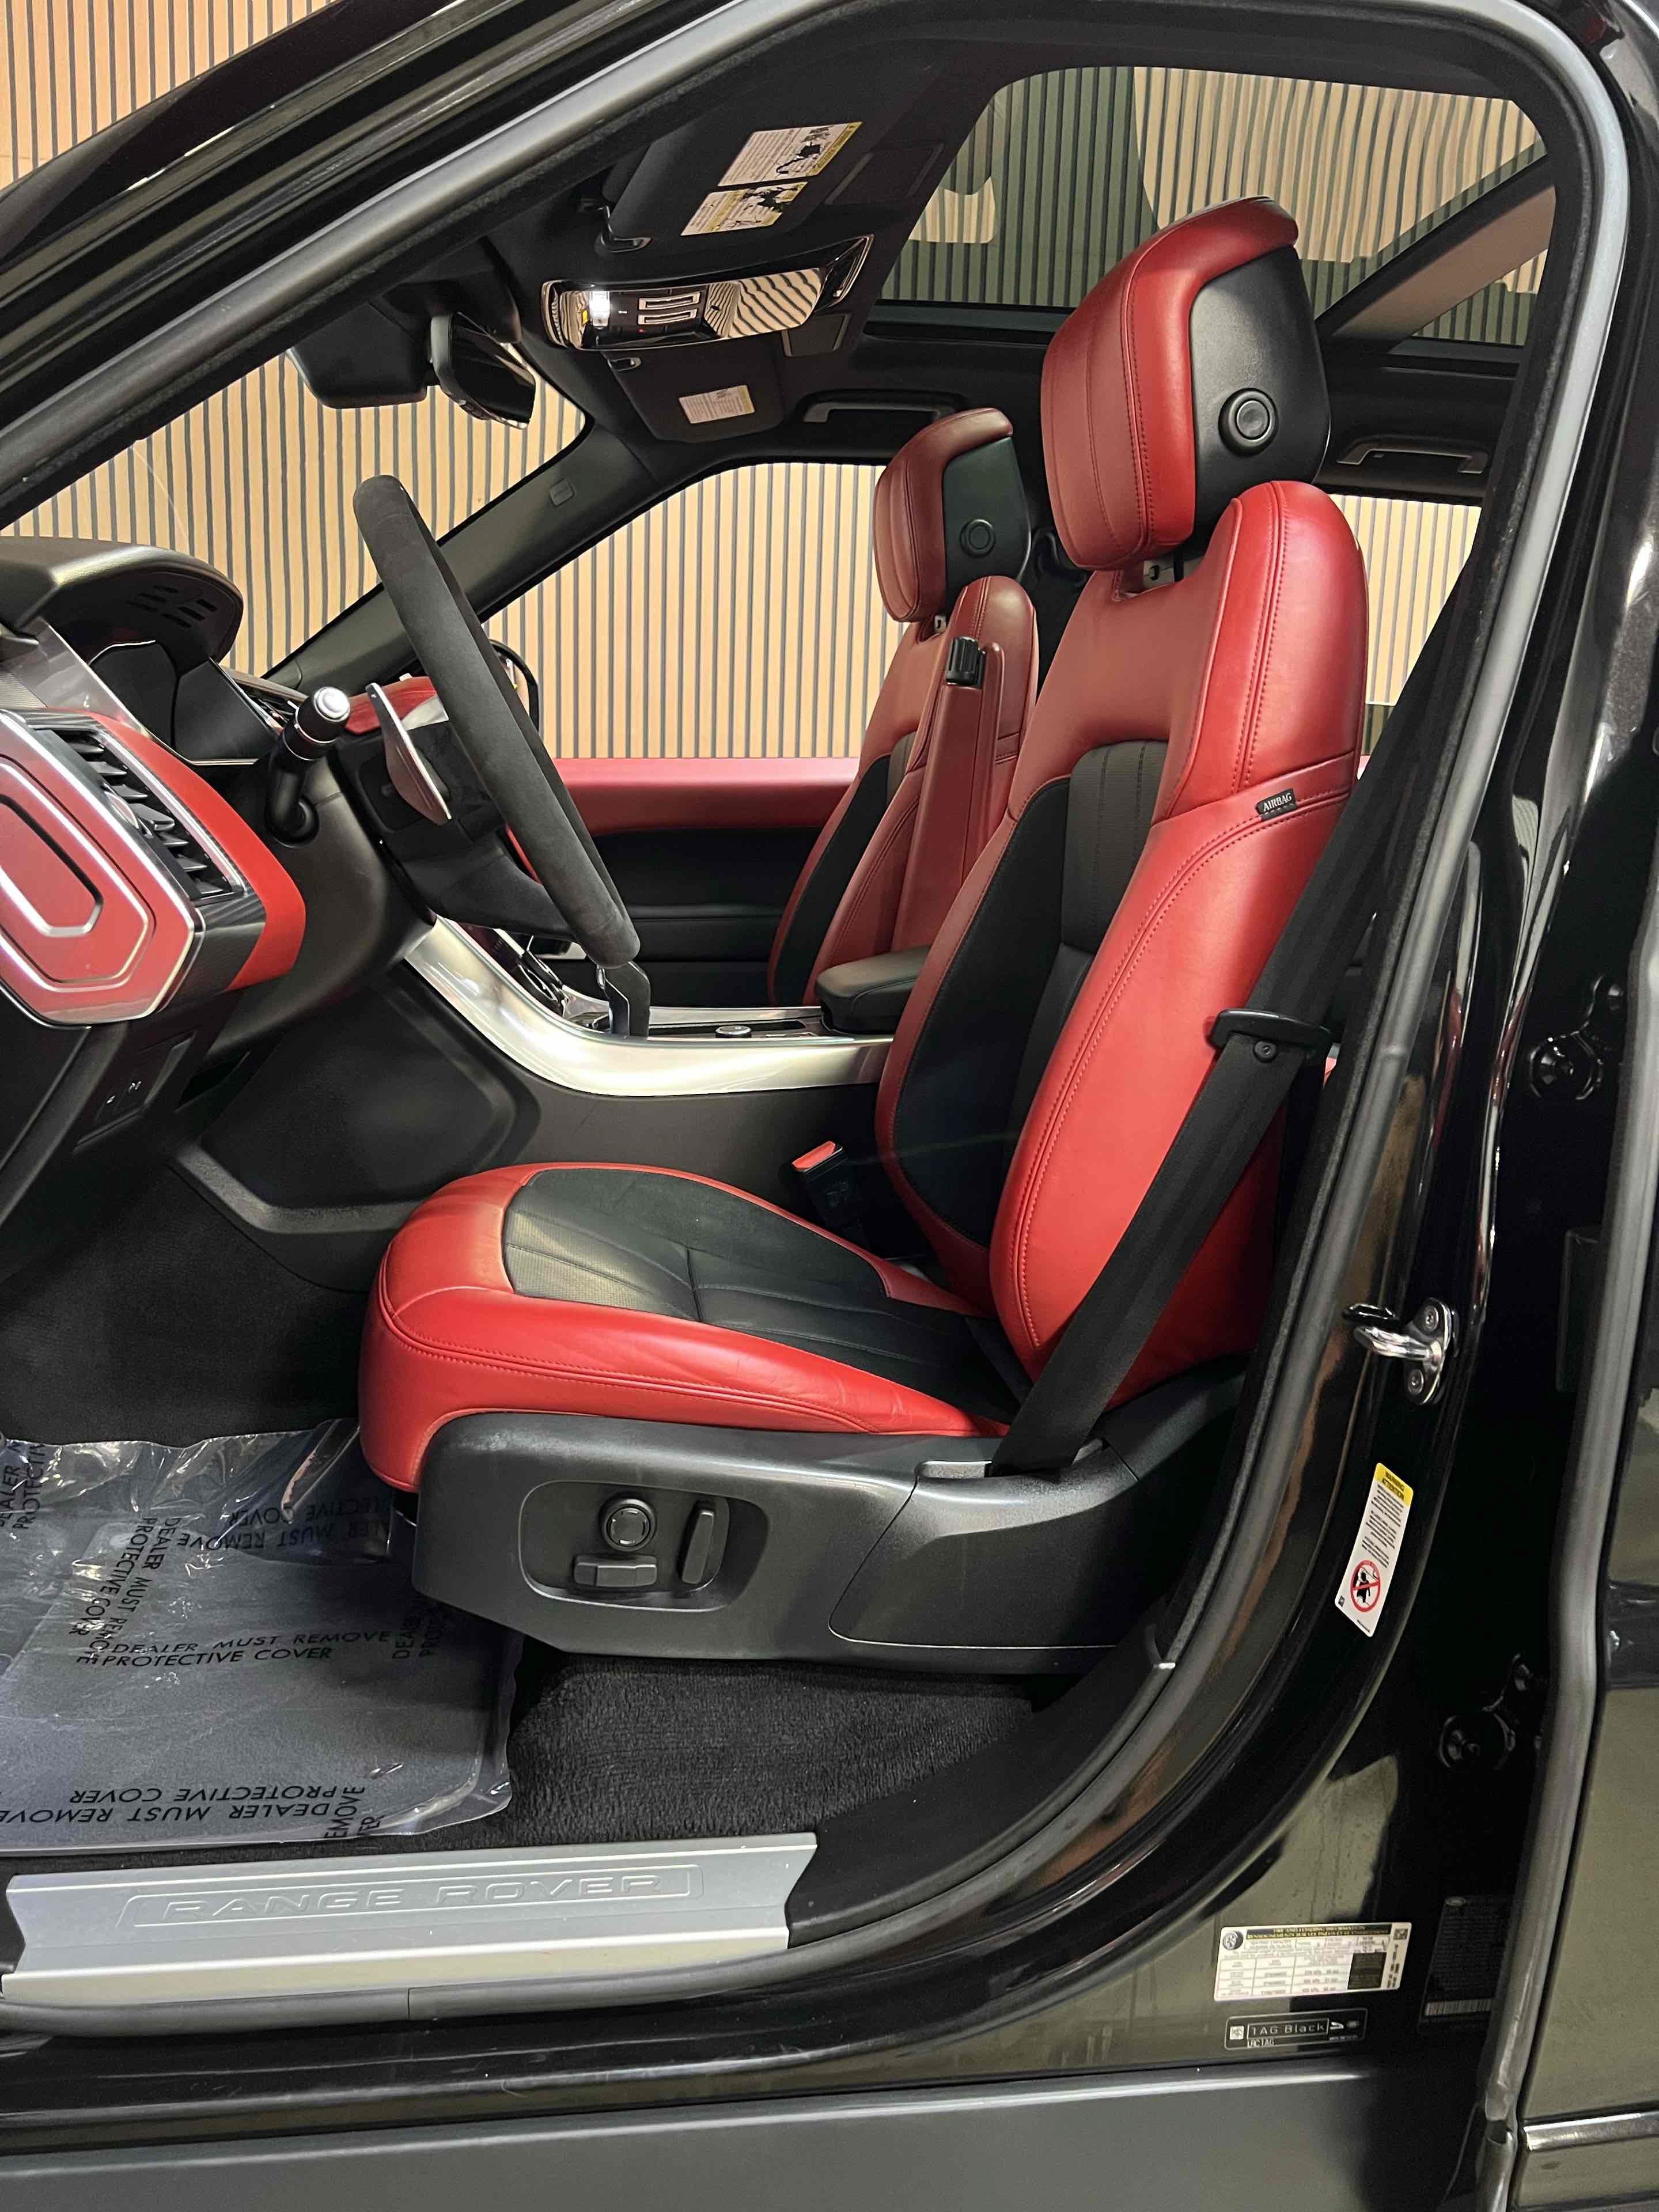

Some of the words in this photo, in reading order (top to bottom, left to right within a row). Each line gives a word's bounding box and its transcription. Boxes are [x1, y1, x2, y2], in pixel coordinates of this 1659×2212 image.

[1263, 793, 1292, 812] AIRBAG
[142, 1517, 181, 1569] DEALER
[177, 1529, 266, 1550] REMOVE
[278, 1524, 332, 1547] MUST
[100, 1517, 157, 1594] PROTECTIVE
[118, 1577, 152, 1612] MUST
[111, 1643, 199, 1654] DEALER
[213, 1636, 282, 1649] MUST
[293, 1631, 392, 1645] REMOVE
[101, 1650, 244, 1666] PROTECTIVE
[255, 1647, 332, 1661] COVER
[69, 1787, 162, 1803] COVER
[173, 1786, 337, 1801] PROTECTIVE
[127, 1806, 211, 1822] MUST
[229, 1803, 330, 1819] DEALER
[324, 1787, 365, 1838] EMOVE
[162, 1888, 404, 1919] RANGE
[435, 1874, 663, 1905] ROVER
[1284, 2022, 1325, 2033] Black
